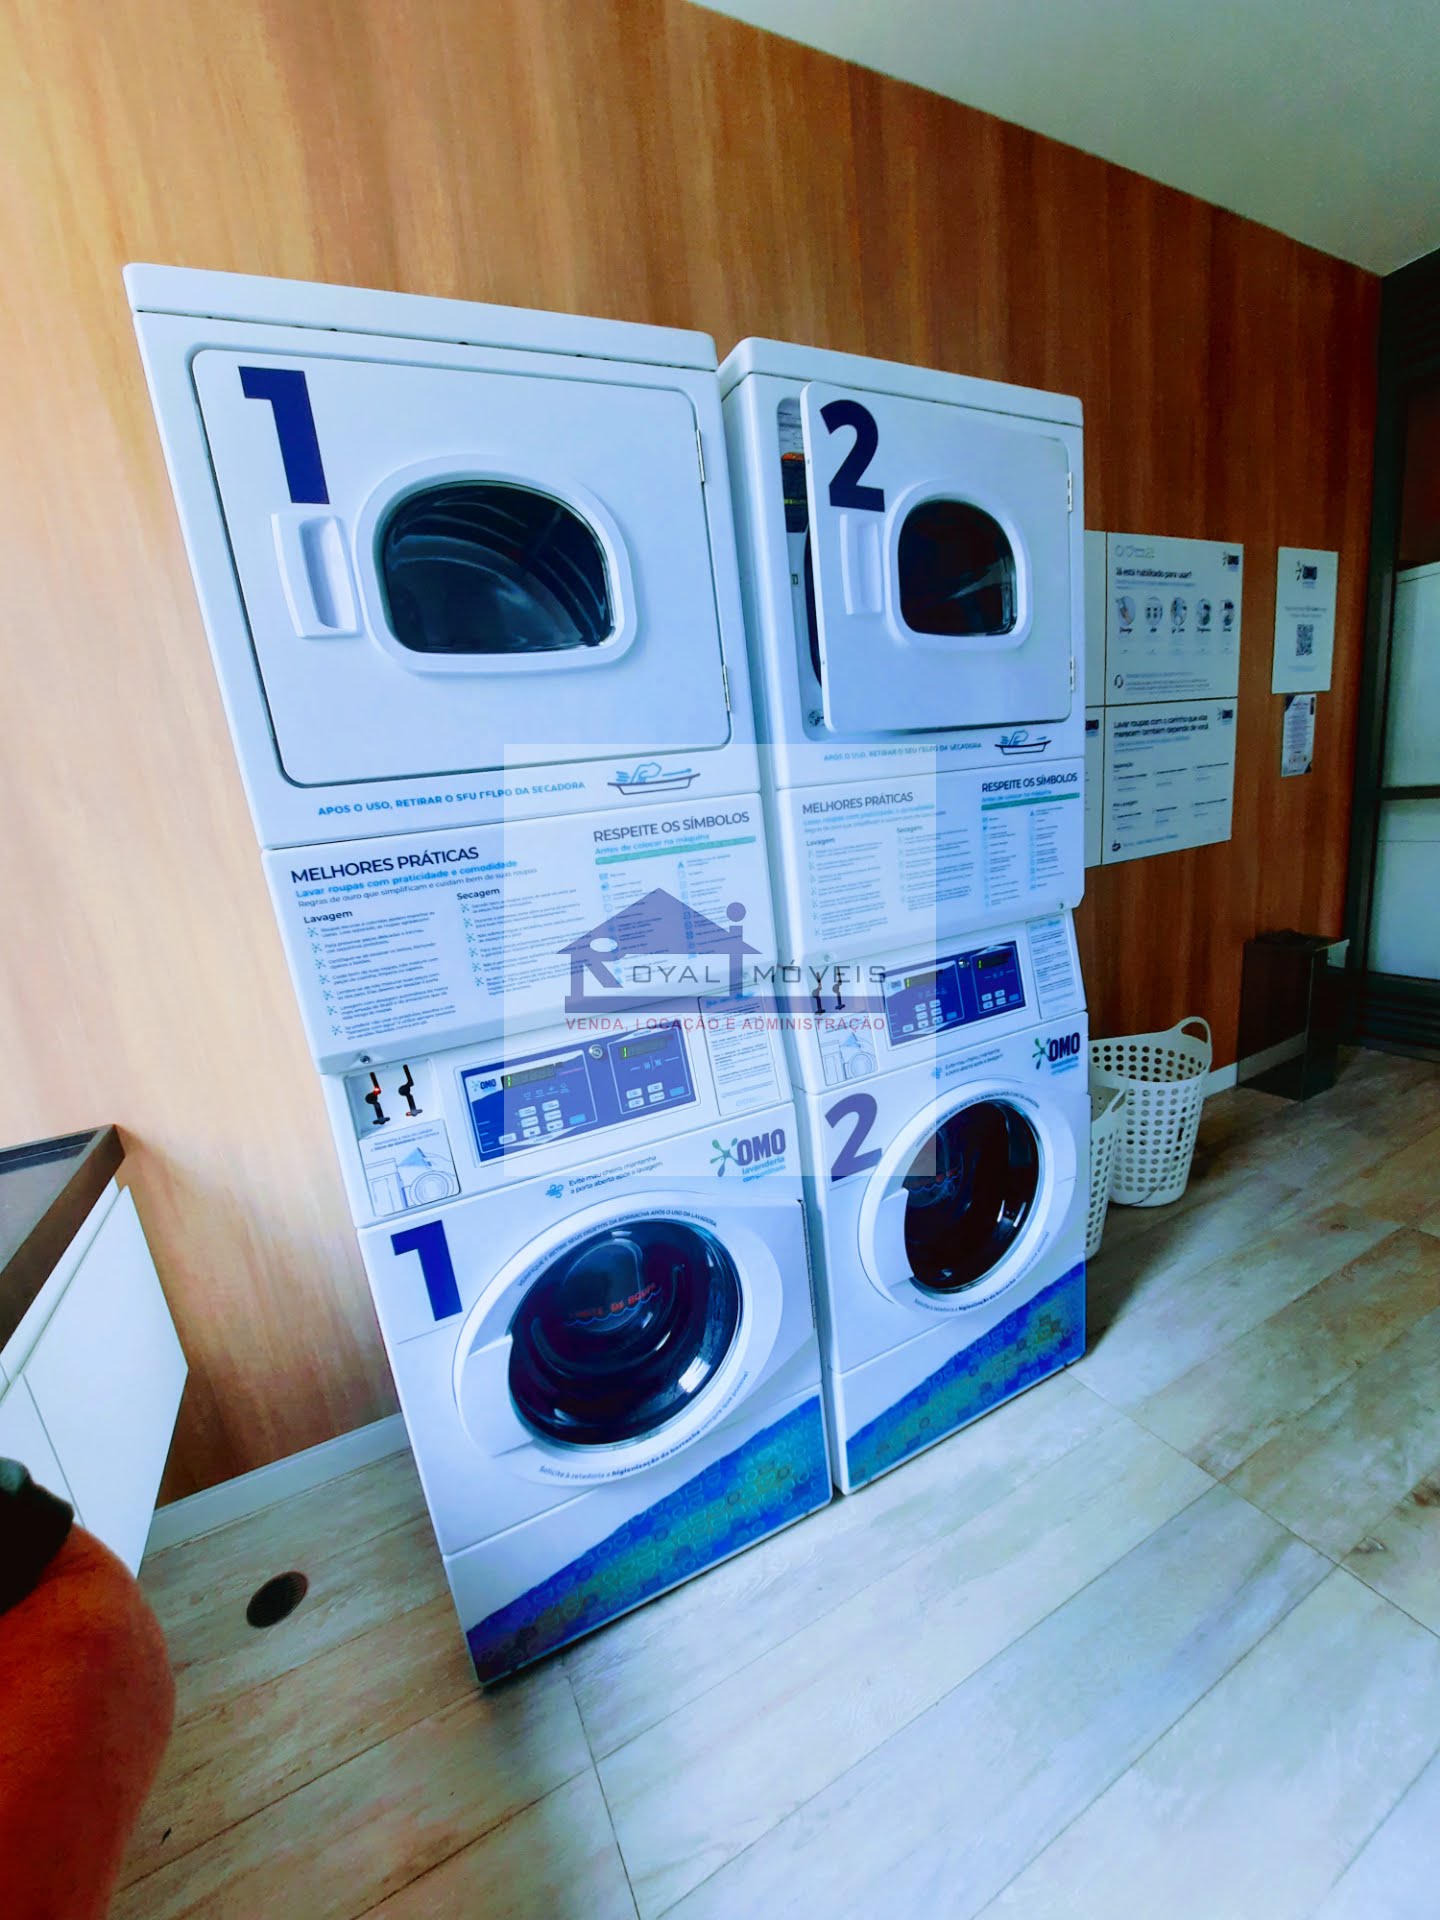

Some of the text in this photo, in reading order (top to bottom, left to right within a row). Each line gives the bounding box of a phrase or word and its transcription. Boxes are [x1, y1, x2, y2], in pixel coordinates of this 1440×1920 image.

[238, 366, 330, 504] 1
[820, 399, 885, 512] 2
[982, 772, 1078, 793] RESPEITE OS SÍMBOLOS
[802, 797, 863, 815] MELHORES
[865, 791, 914, 808] PRÁTICAS
[593, 811, 750, 843] RESPEITE OS SÍMBOLOS
[291, 846, 479, 884] MELHORES PRÁTICAS
[296, 887, 325, 898] Lavar
[328, 882, 365, 893] roupas
[367, 878, 390, 888] com
[392, 869, 449, 885] praticidade
[459, 860, 518, 875] comodidade
[456, 887, 501, 901] Secagem
[303, 910, 354, 924] Lavagem
[1048, 1032, 1080, 1062] OMO
[737, 1128, 786, 1166] OMO
[824, 1092, 882, 1183] 2
[390, 1219, 463, 1322] 1
